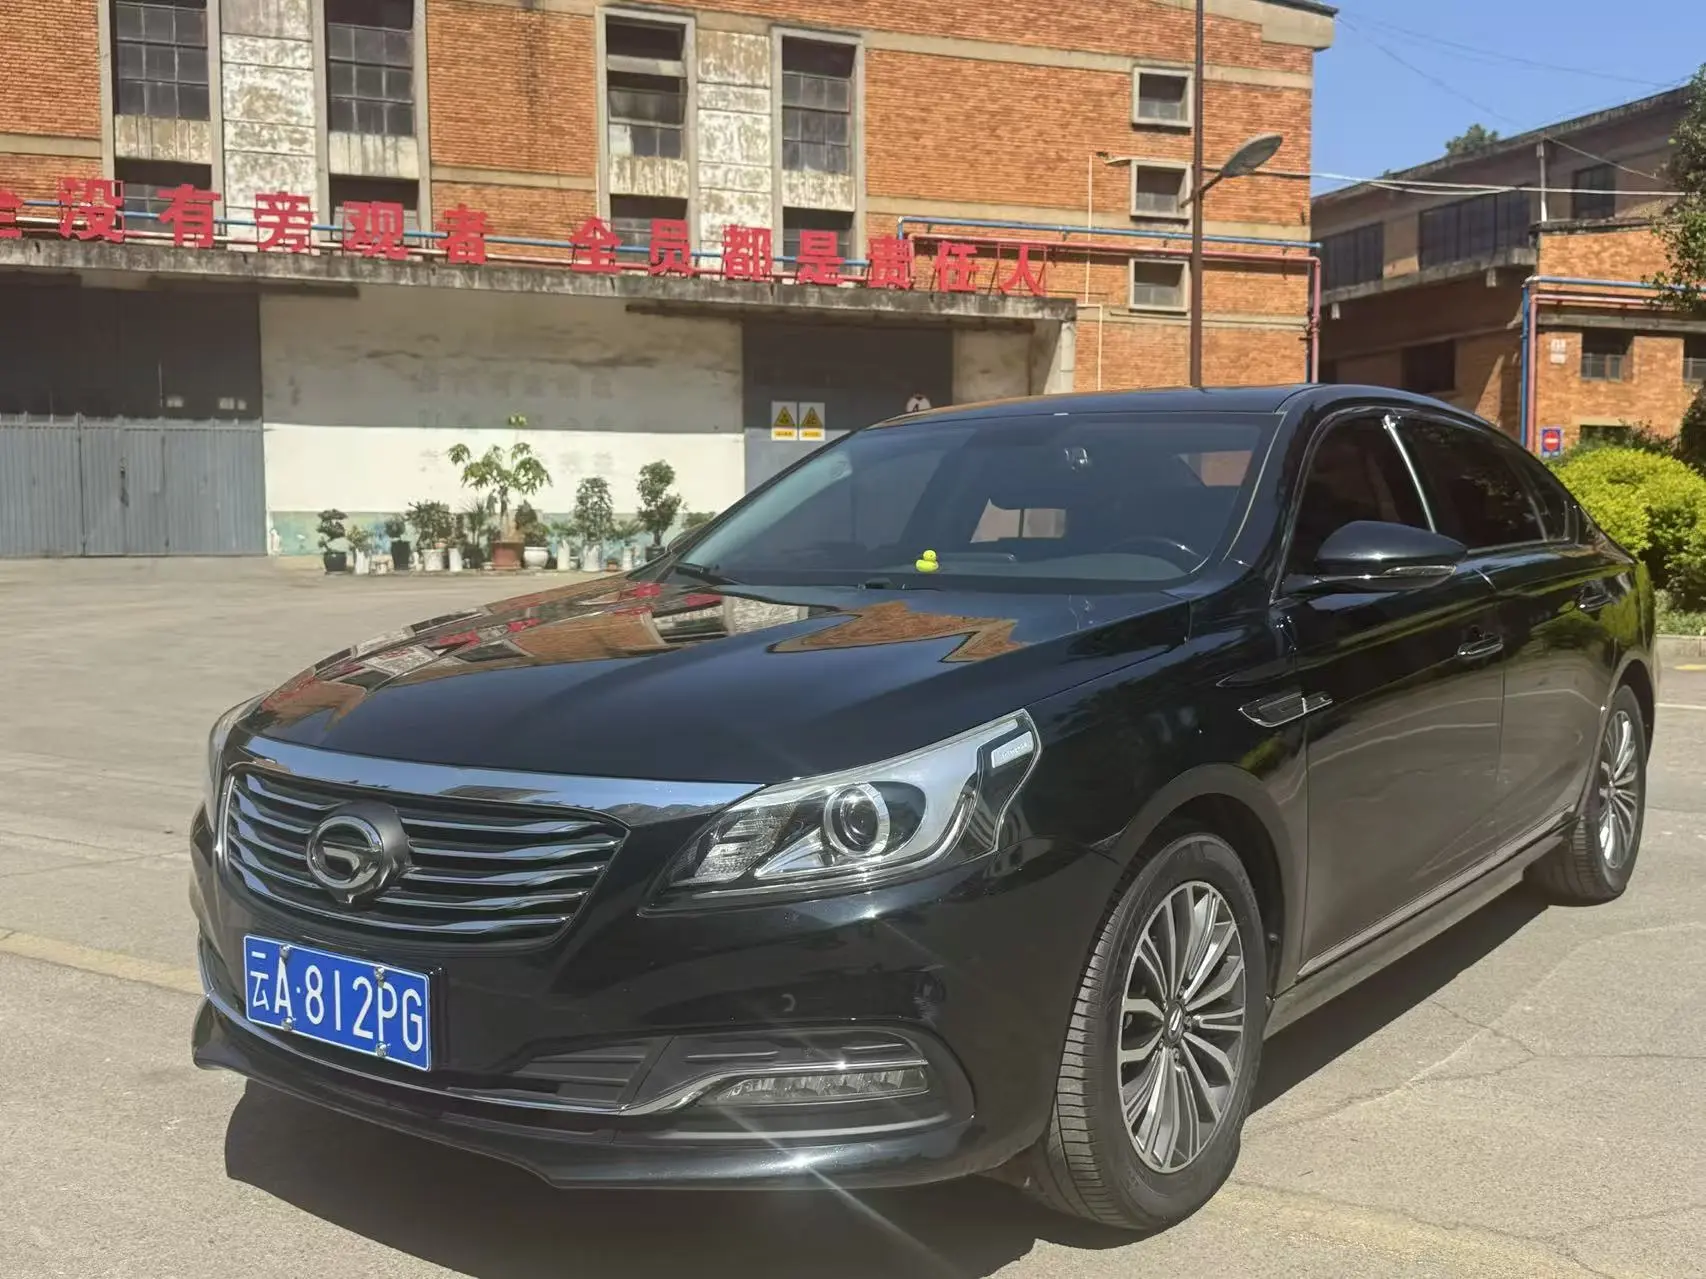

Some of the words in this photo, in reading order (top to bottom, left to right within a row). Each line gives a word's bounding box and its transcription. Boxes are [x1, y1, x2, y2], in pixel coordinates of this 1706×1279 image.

[568, 217, 1046, 297] 全员都是责任人
